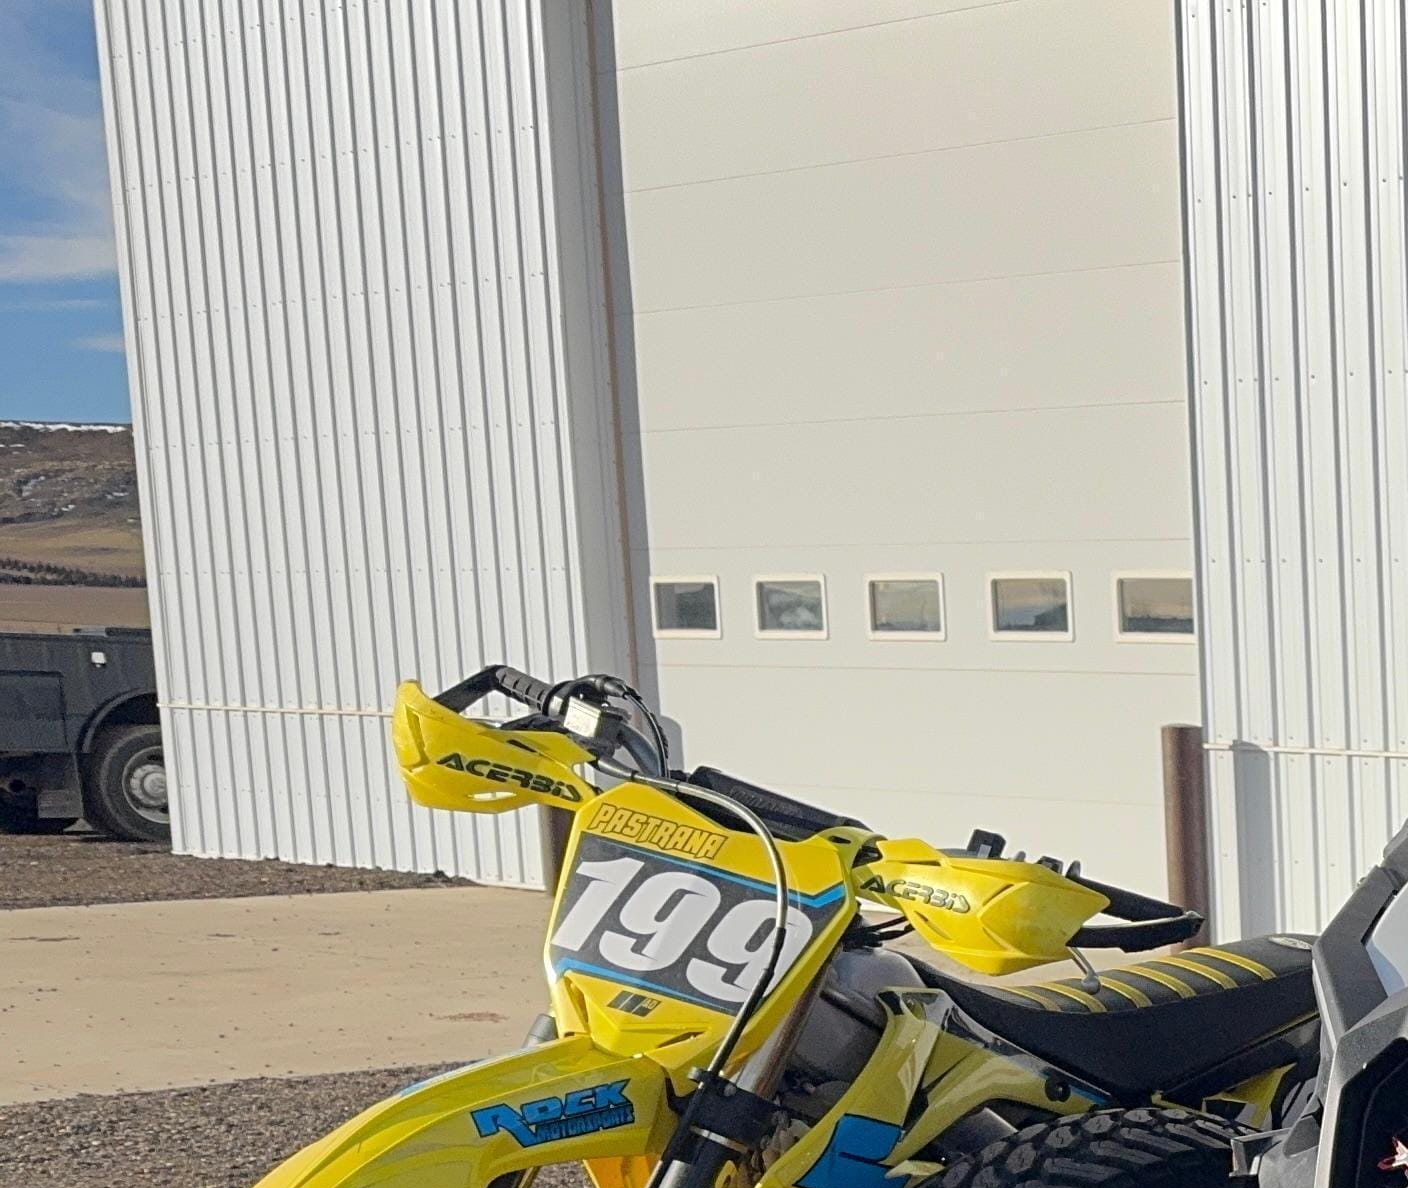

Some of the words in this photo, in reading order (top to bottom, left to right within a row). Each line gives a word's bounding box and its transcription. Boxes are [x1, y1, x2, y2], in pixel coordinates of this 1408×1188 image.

[437, 753, 585, 802] ACERBIS
[588, 803, 728, 862] PASTRANA
[551, 857, 813, 1003] 199
